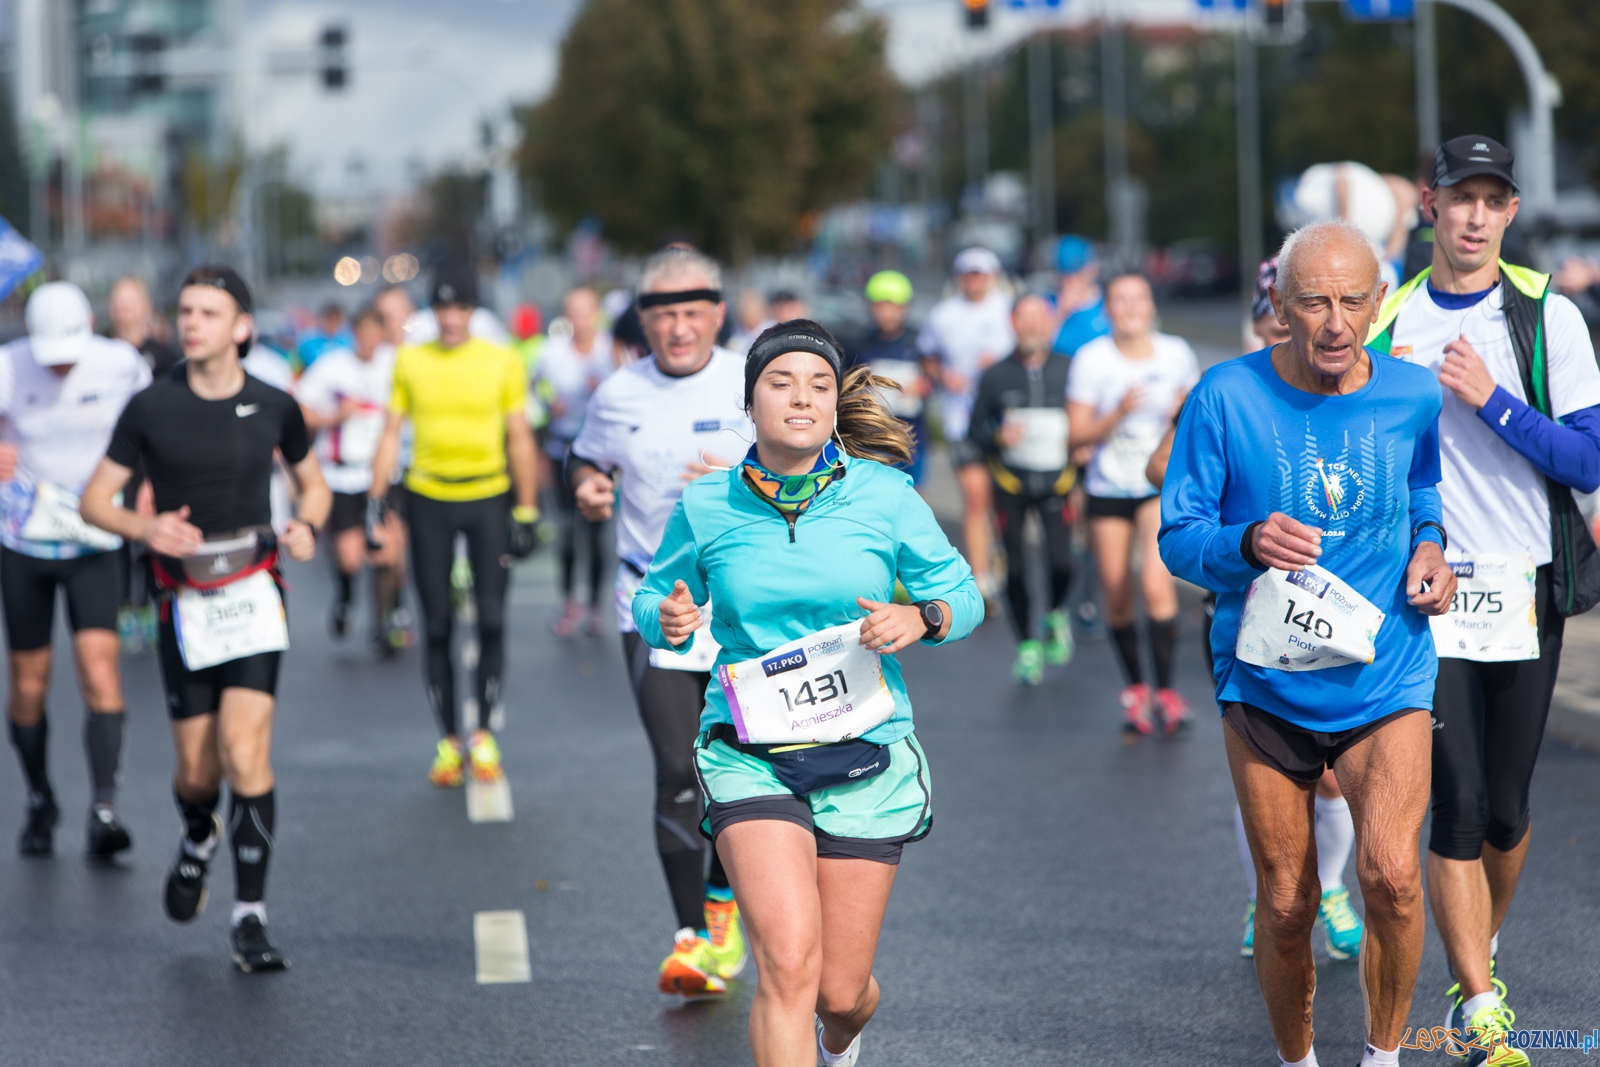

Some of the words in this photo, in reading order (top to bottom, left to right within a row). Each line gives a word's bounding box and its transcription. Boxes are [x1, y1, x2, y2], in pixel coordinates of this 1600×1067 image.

[1327, 463, 1346, 471] TCS
[1348, 468, 1364, 486] NEW
[1305, 474, 1327, 519] MARATHON
[1350, 489, 1365, 512] YORK
[1329, 511, 1350, 521] CITY
[1284, 598, 1333, 640] 140
[1454, 619, 1493, 630] Marcin
[810, 642, 845, 660] maraton
[1288, 634, 1318, 652] Piotr
[778, 669, 849, 712] 1431
[791, 702, 853, 731] Agnieszka
